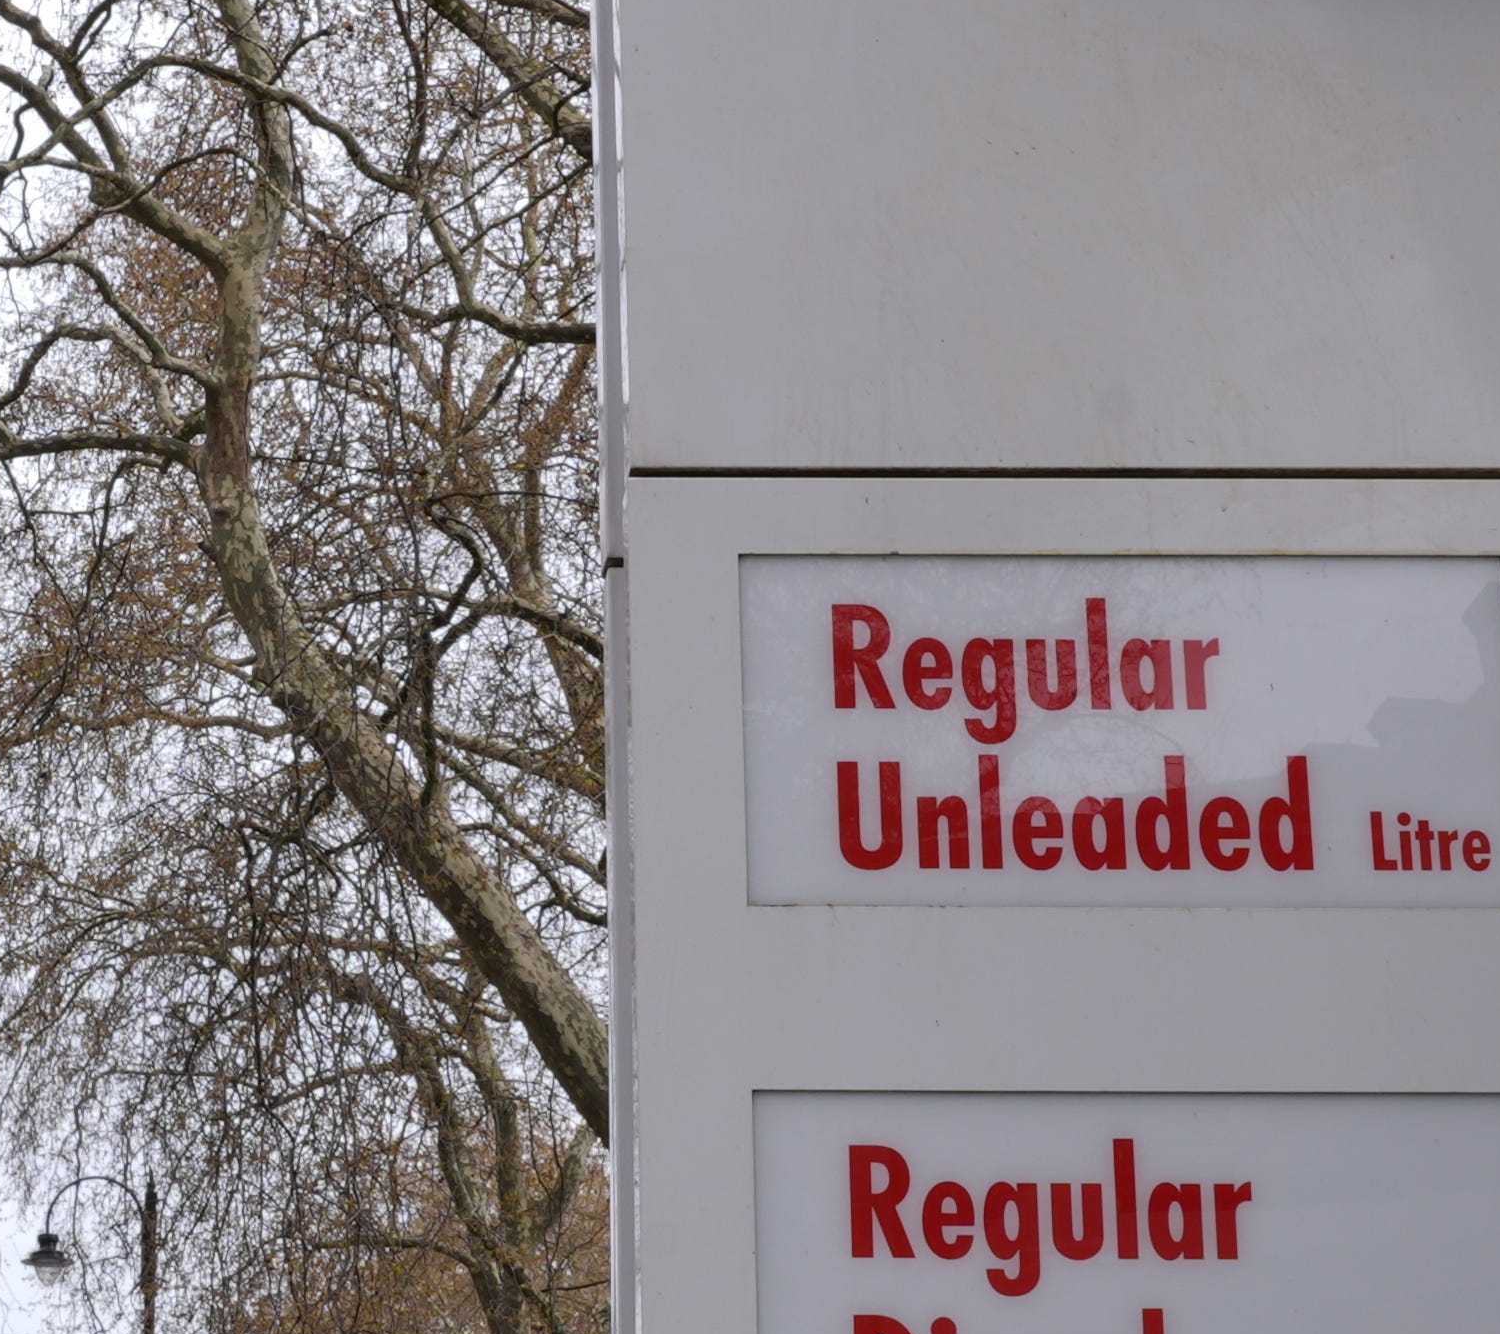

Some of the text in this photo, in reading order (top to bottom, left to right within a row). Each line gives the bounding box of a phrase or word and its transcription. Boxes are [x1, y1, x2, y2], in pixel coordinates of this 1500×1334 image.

[831, 597, 1220, 745] Regular
[836, 754, 1493, 872] Unleaded Litre
[848, 1138, 1252, 1297] Regular
